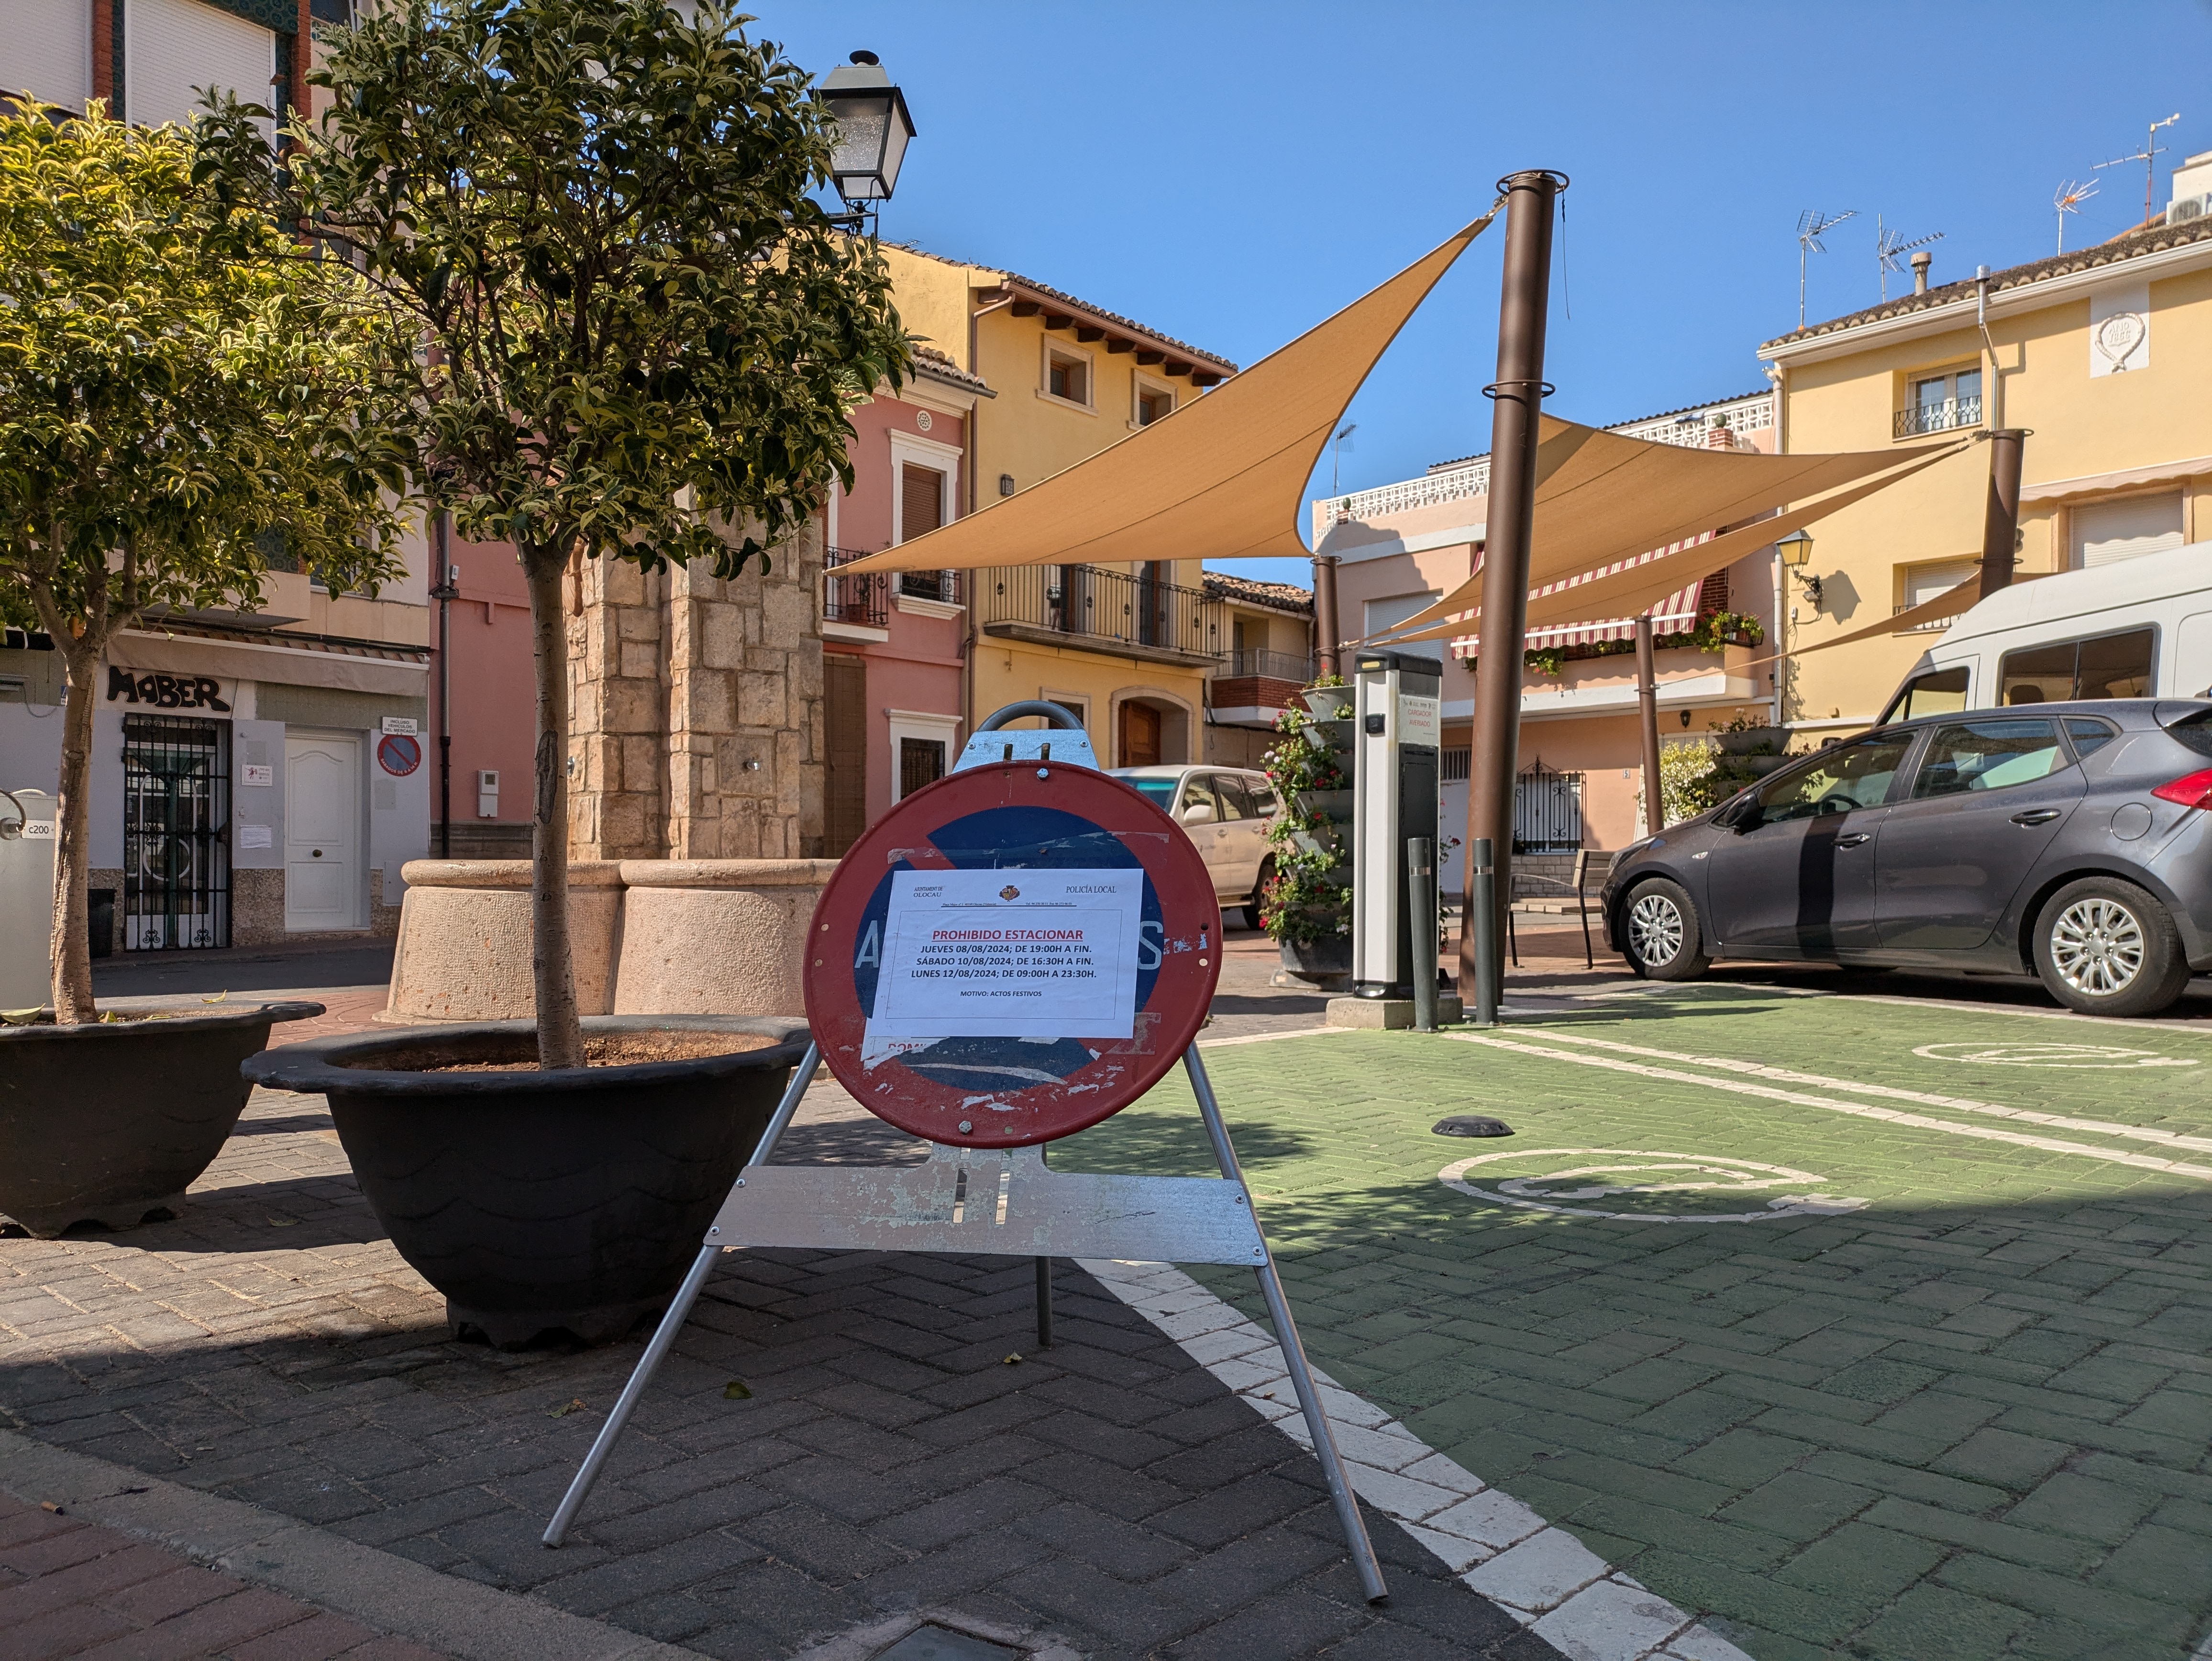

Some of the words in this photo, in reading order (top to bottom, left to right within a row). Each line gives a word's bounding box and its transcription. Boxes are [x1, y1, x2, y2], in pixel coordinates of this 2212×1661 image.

[106, 665, 231, 712] MABER
[1408, 709, 1432, 717] CARGADOR
[29, 825, 49, 834] c200
[1066, 885, 1092, 893] POLICÍA
[932, 930, 1002, 940] PROHIBIDO
[1005, 930, 1084, 940] ESTACIONAR
[956, 945, 1012, 954] 08/08/2024;
[917, 956, 955, 965] SÁBADO
[957, 957, 1014, 966] 10/08/2024;
[943, 969, 999, 978] 12/08/2024;
